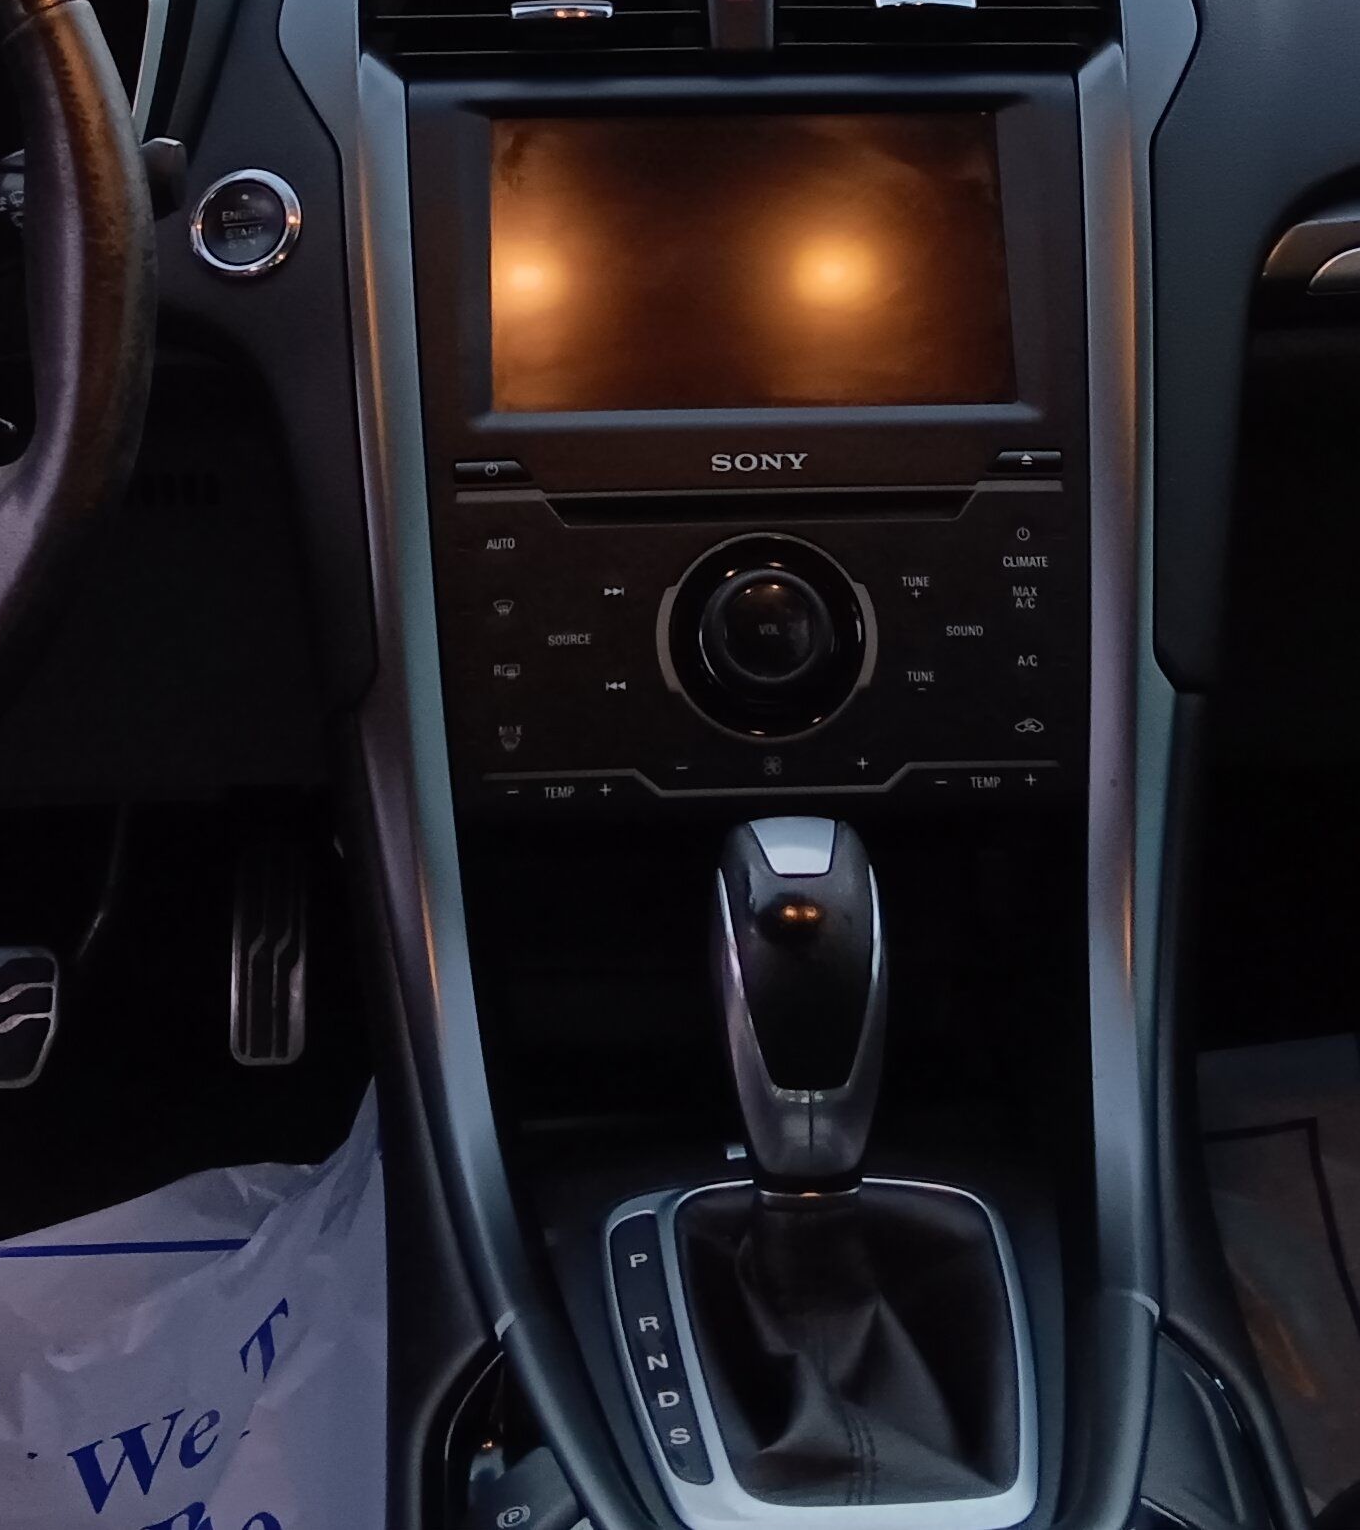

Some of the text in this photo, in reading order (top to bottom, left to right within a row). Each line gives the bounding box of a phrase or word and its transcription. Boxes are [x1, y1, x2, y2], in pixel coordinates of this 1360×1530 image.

[711, 453, 809, 472] SONY
[486, 536, 516, 551] AUTO
[1002, 555, 1049, 569] CLIMATE
[901, 575, 931, 588] TUNE
[1012, 585, 1038, 597] MAX
[1015, 597, 1036, 609] A/C
[758, 623, 780, 636] VOL
[945, 624, 984, 637] SOUND
[547, 632, 592, 647] SOURCE
[1017, 654, 1039, 668] A/C
[907, 671, 936, 683] TUNE
[969, 776, 1002, 789] TEMP
[544, 785, 576, 800] TEMP
[629, 1253, 648, 1268] P
[639, 1316, 659, 1332] R
[646, 1353, 669, 1370] N
[658, 1391, 680, 1408] D
[670, 1427, 691, 1444] S
[67, 1408, 221, 1514] We
